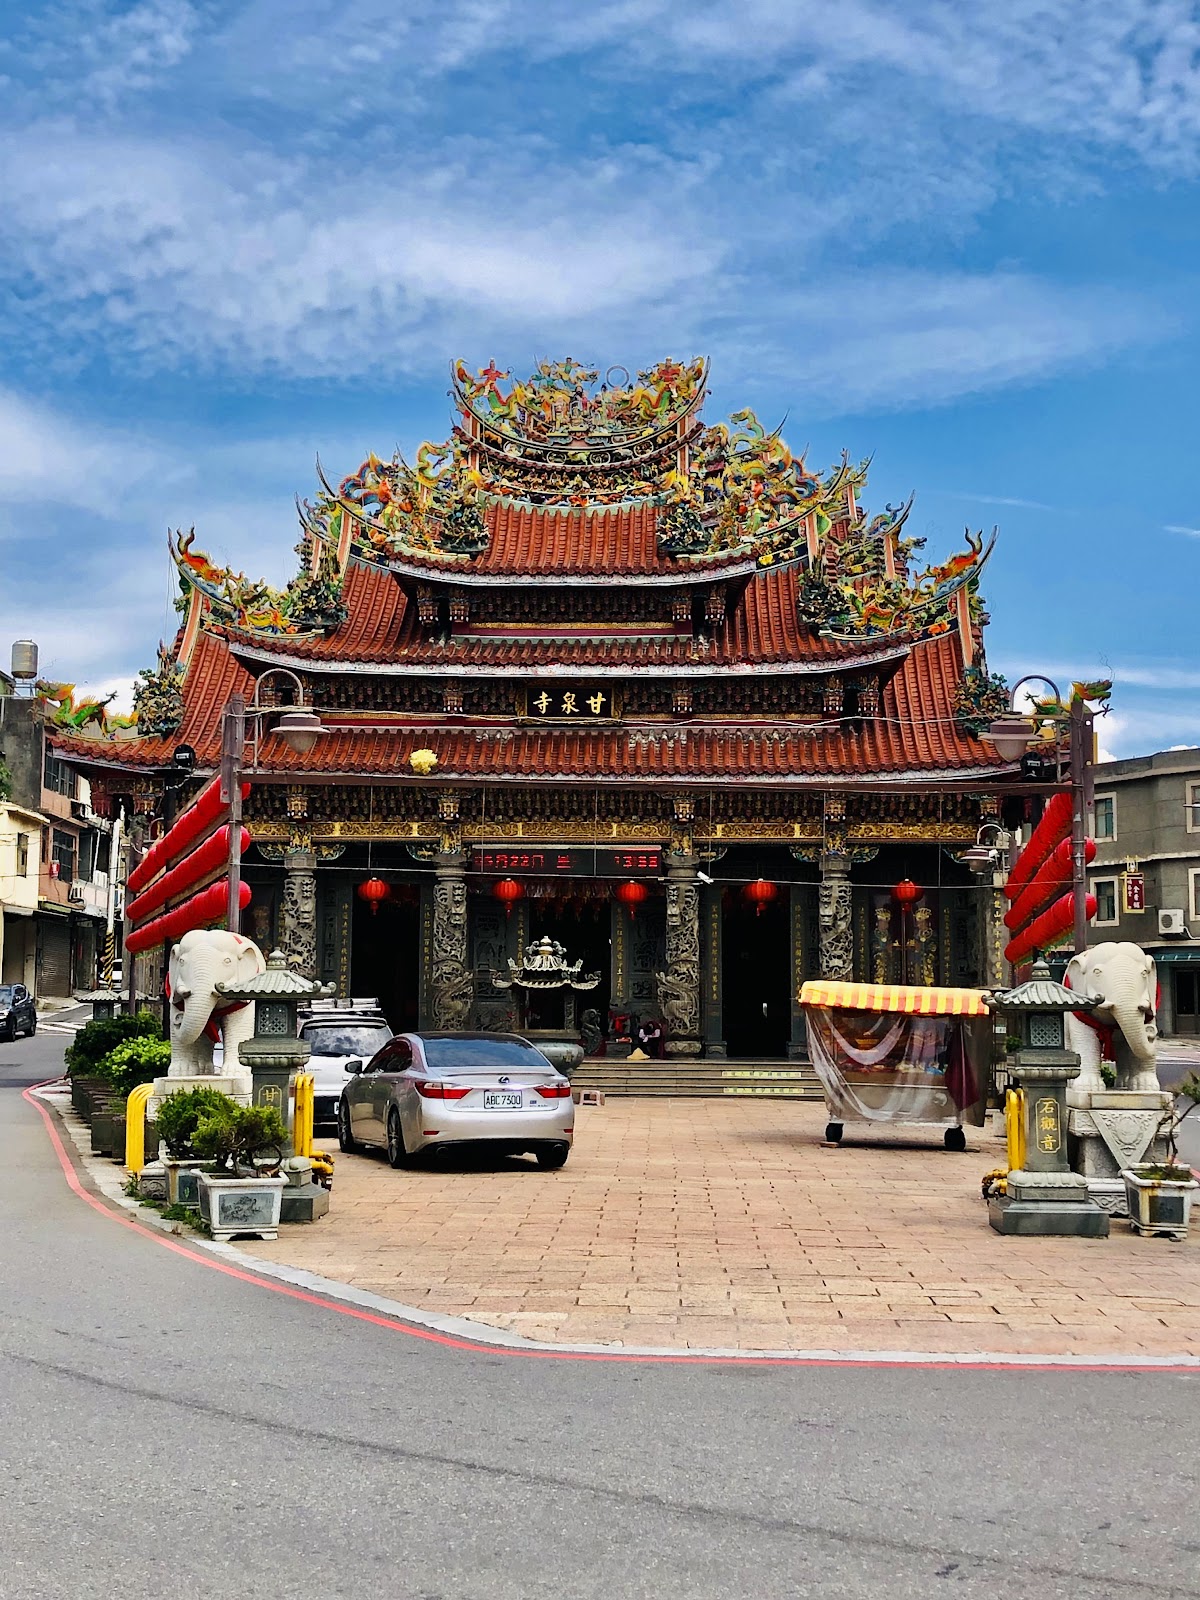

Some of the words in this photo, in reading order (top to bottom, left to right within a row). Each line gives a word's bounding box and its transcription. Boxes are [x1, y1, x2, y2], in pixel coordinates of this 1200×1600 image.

[532, 690, 607, 715] 甘泉寺
[485, 1095, 500, 1105] ABC
[501, 1094, 521, 1105] 7300
[1039, 1101, 1058, 1151] 石觀音
